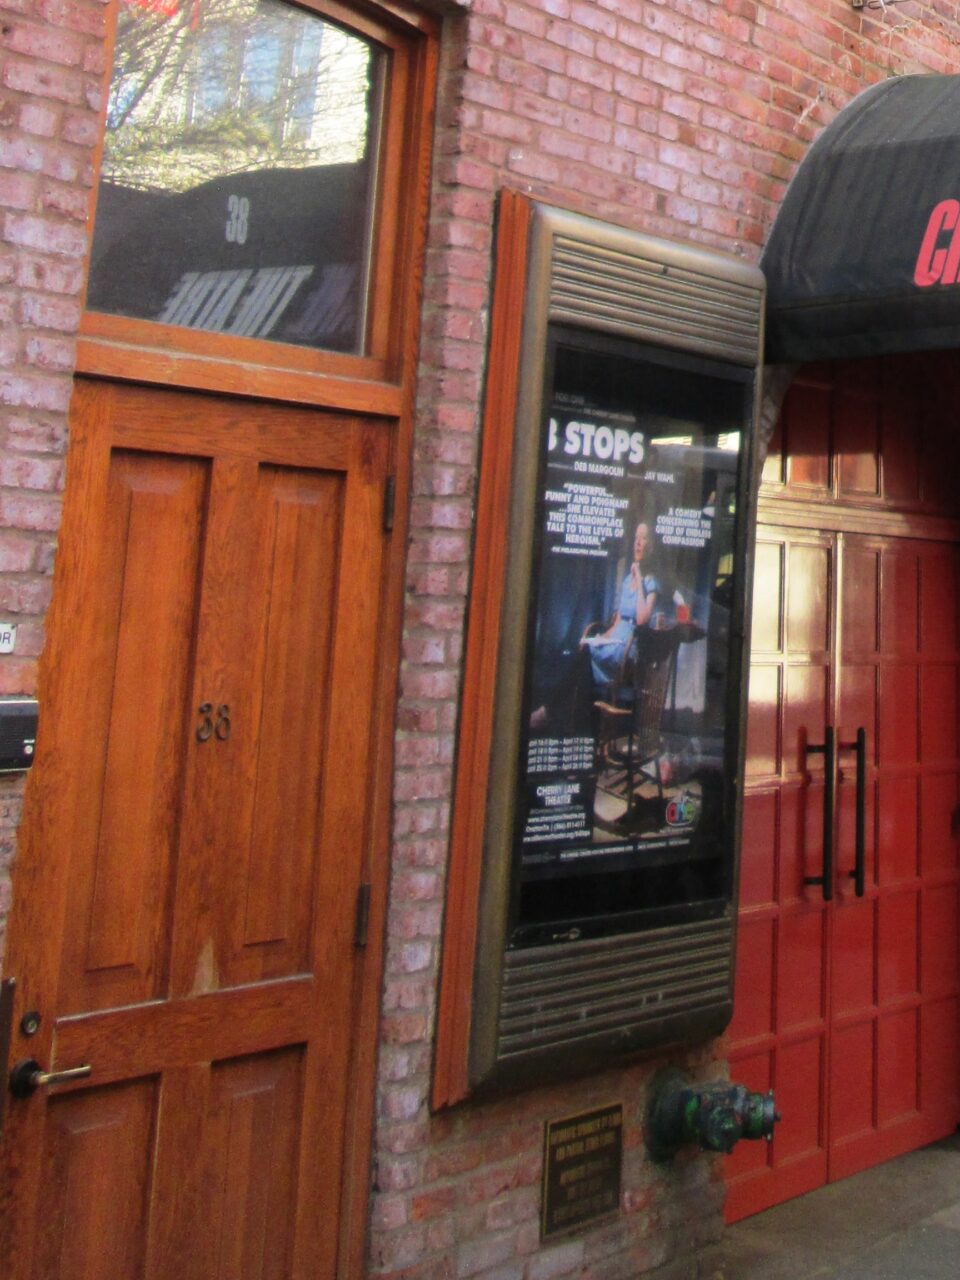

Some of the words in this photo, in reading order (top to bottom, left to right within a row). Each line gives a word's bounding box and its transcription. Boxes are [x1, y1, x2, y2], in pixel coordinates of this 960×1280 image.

[225, 194, 249, 245] 38
[564, 421, 645, 464] STOPS
[574, 461, 587, 472] DEB
[545, 491, 572, 502] FUNNY
[572, 495, 589, 504] AND
[549, 512, 566, 522] THIS
[547, 521, 564, 532] TALE
[566, 524, 576, 533] TO
[578, 525, 592, 534] THE
[593, 526, 613, 536] LEVEL
[195, 703, 231, 744] 38
